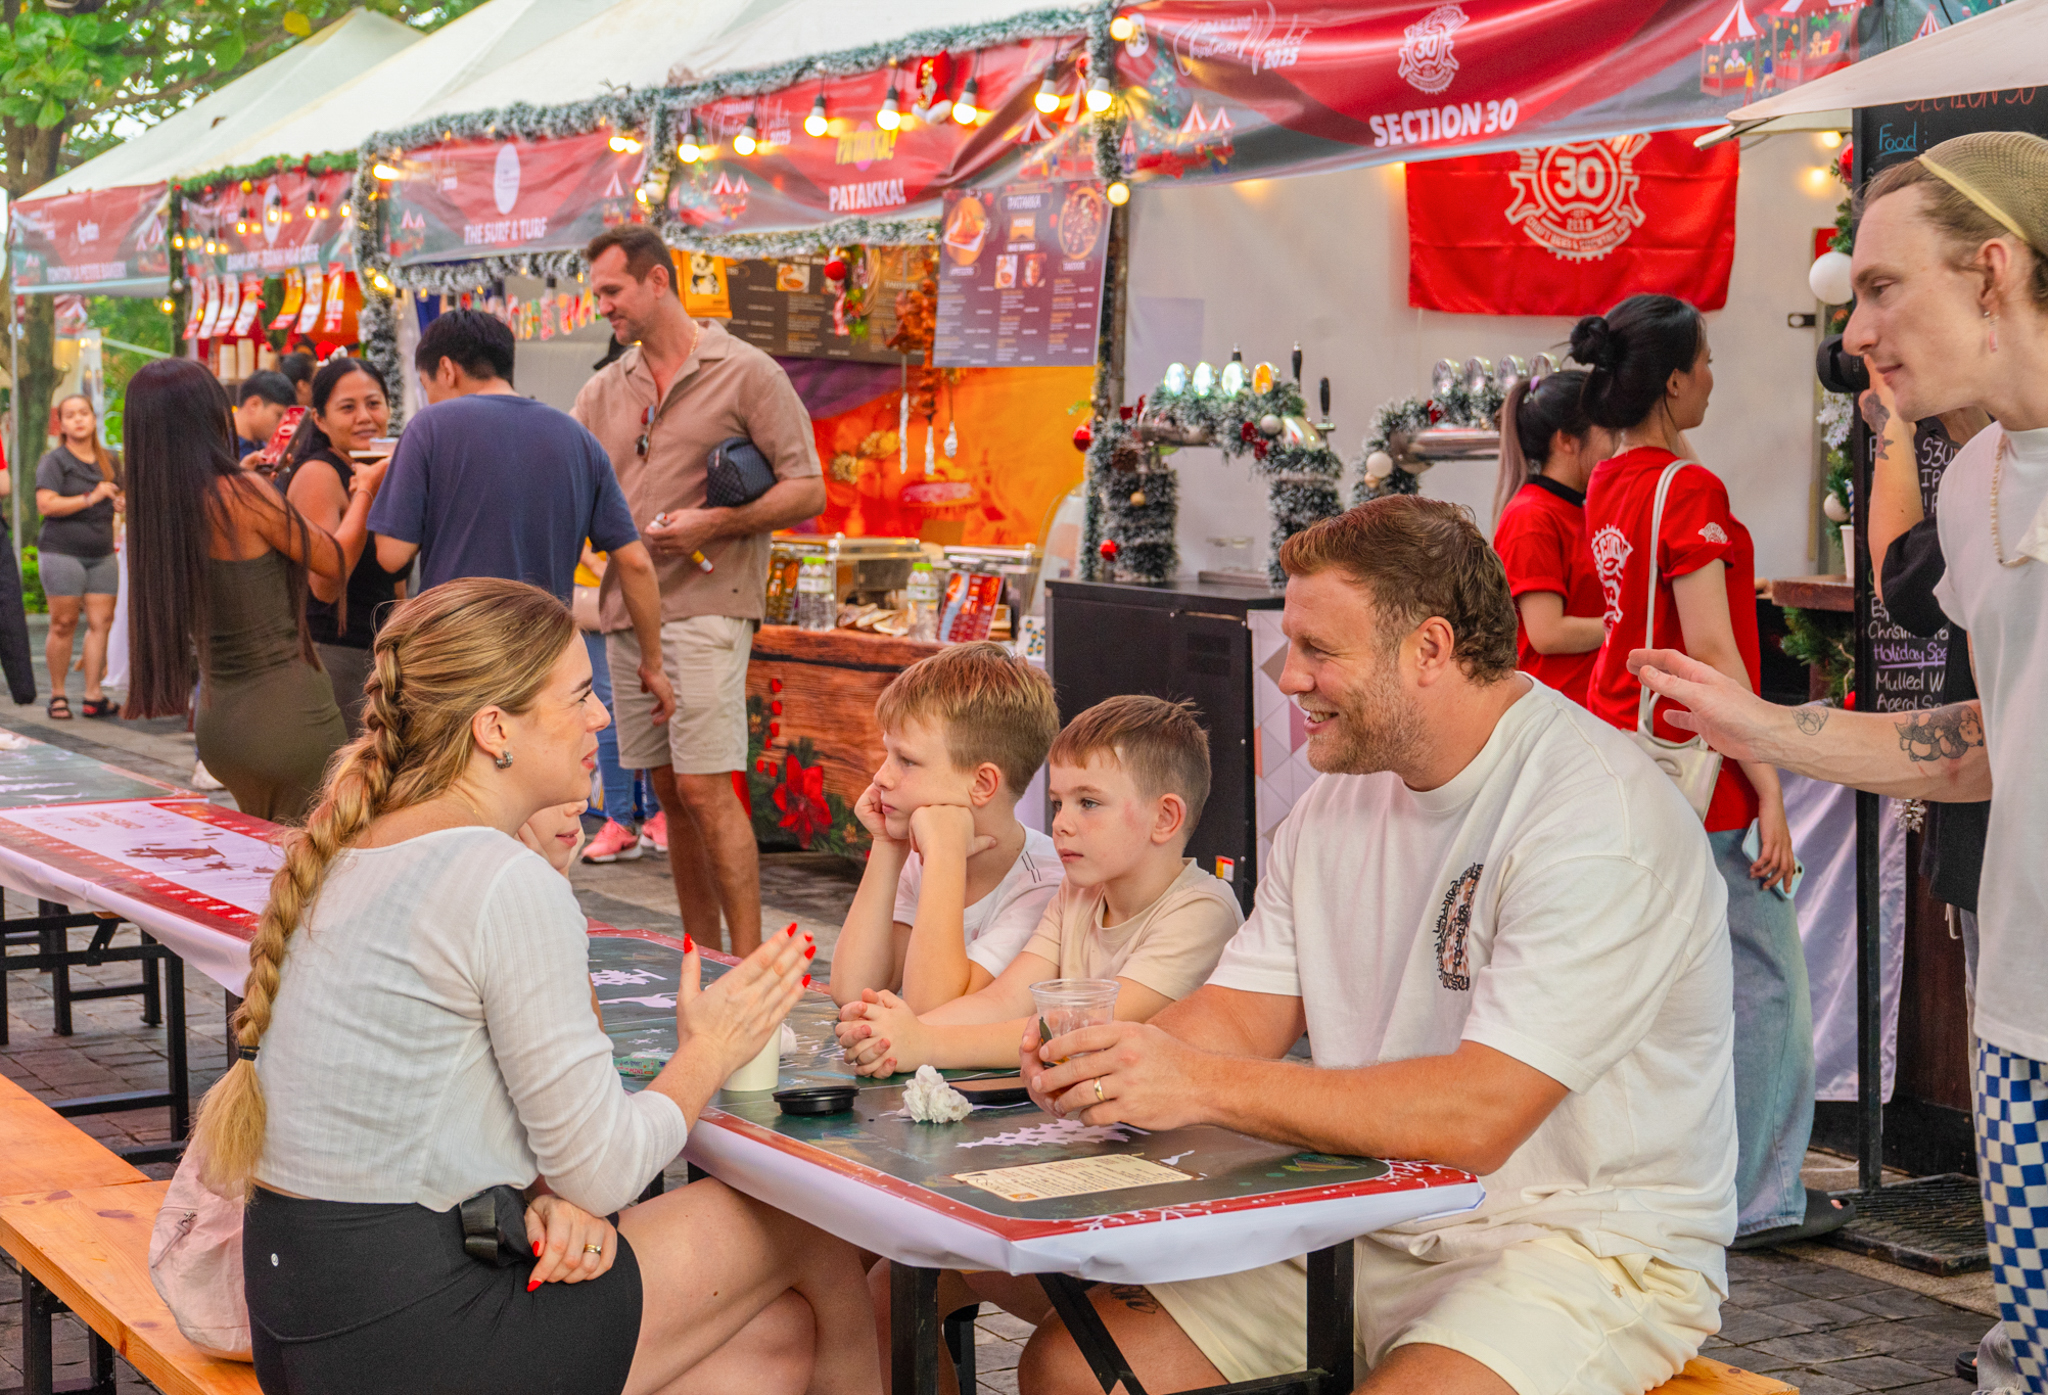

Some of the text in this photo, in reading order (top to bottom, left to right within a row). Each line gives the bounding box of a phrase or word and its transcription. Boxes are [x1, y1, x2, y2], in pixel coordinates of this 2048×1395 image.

[1263, 46, 1300, 70] 2025
[1415, 33, 1438, 60] 30
[1369, 97, 1518, 148] SECTION 30
[1554, 156, 1605, 198] 30
[828, 177, 907, 213] PATAKKA!
[520, 216, 548, 240] TURF
[1873, 641, 1924, 669] Holiday
[1875, 671, 1925, 692] Mulled
